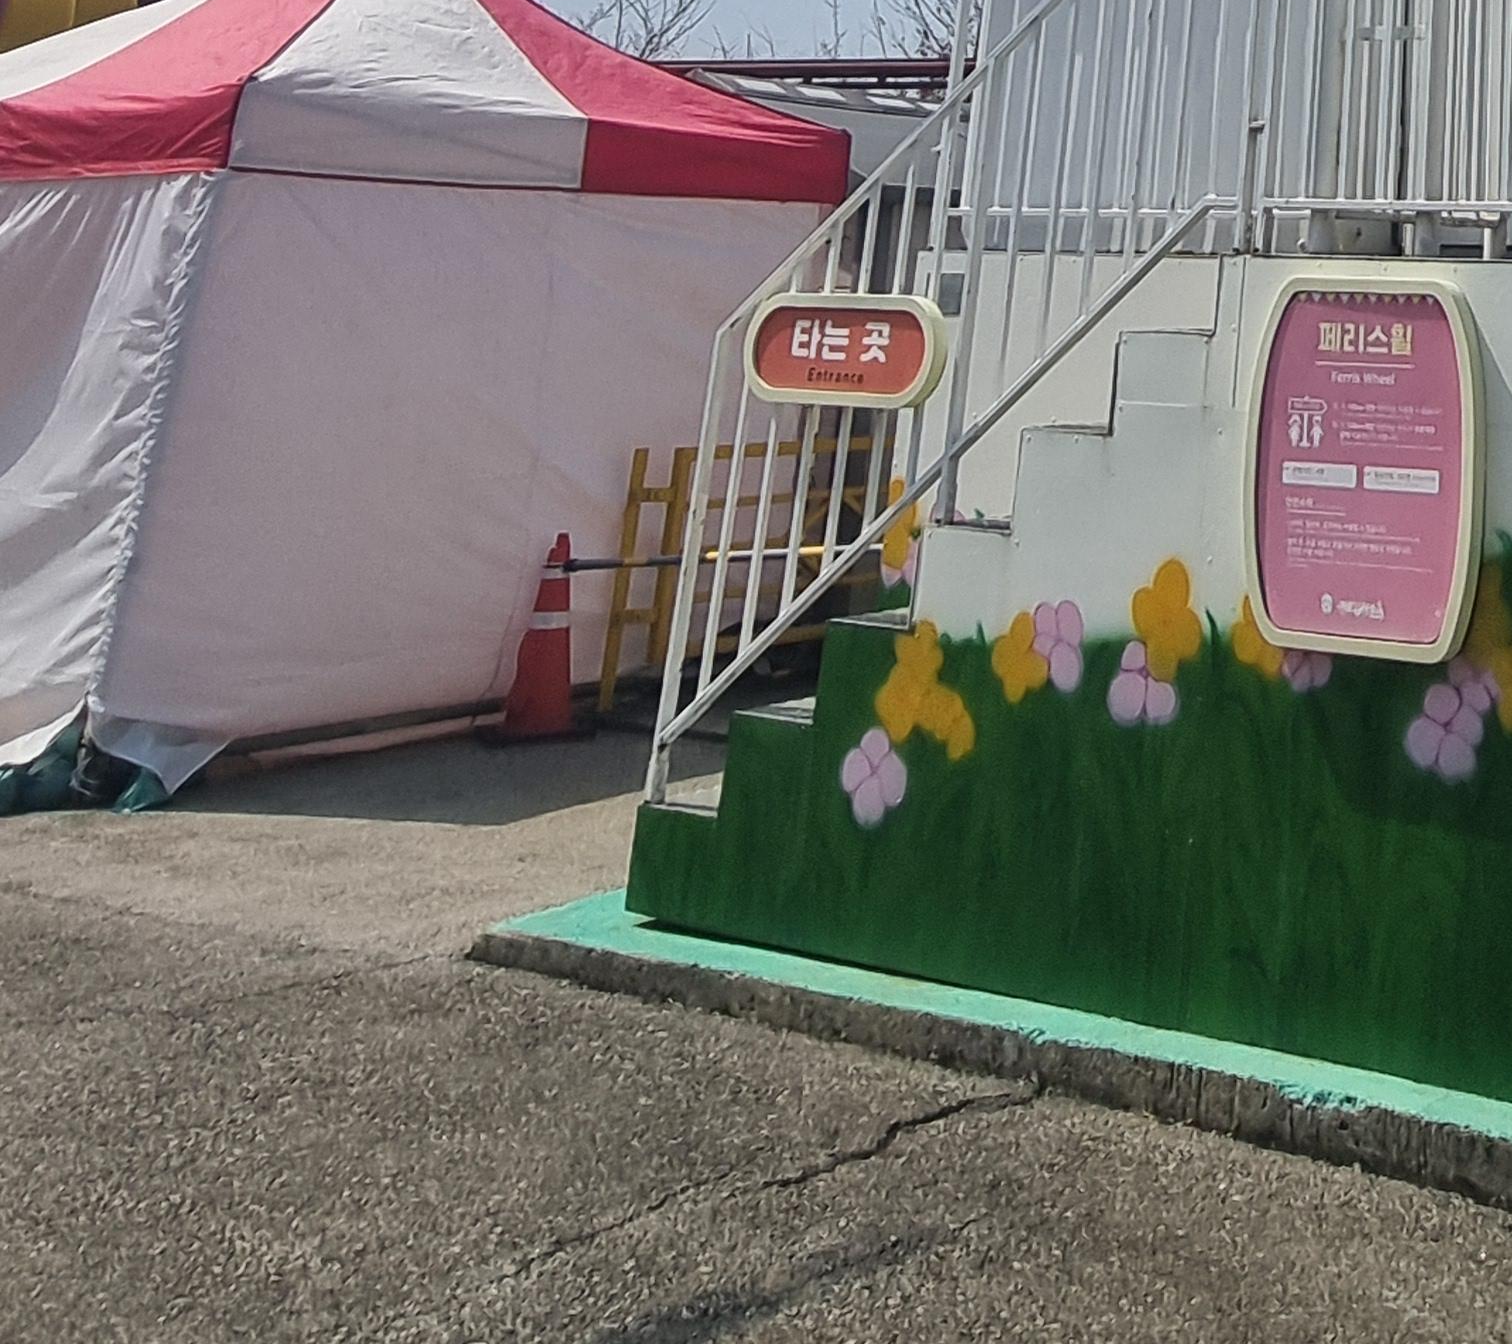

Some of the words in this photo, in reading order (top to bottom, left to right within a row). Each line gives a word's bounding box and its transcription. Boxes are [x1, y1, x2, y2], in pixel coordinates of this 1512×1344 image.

[791, 319, 850, 361] 타는
[859, 321, 891, 363] 곳
[806, 366, 866, 385] Entrance
[1363, 371, 1397, 386] Wheel
